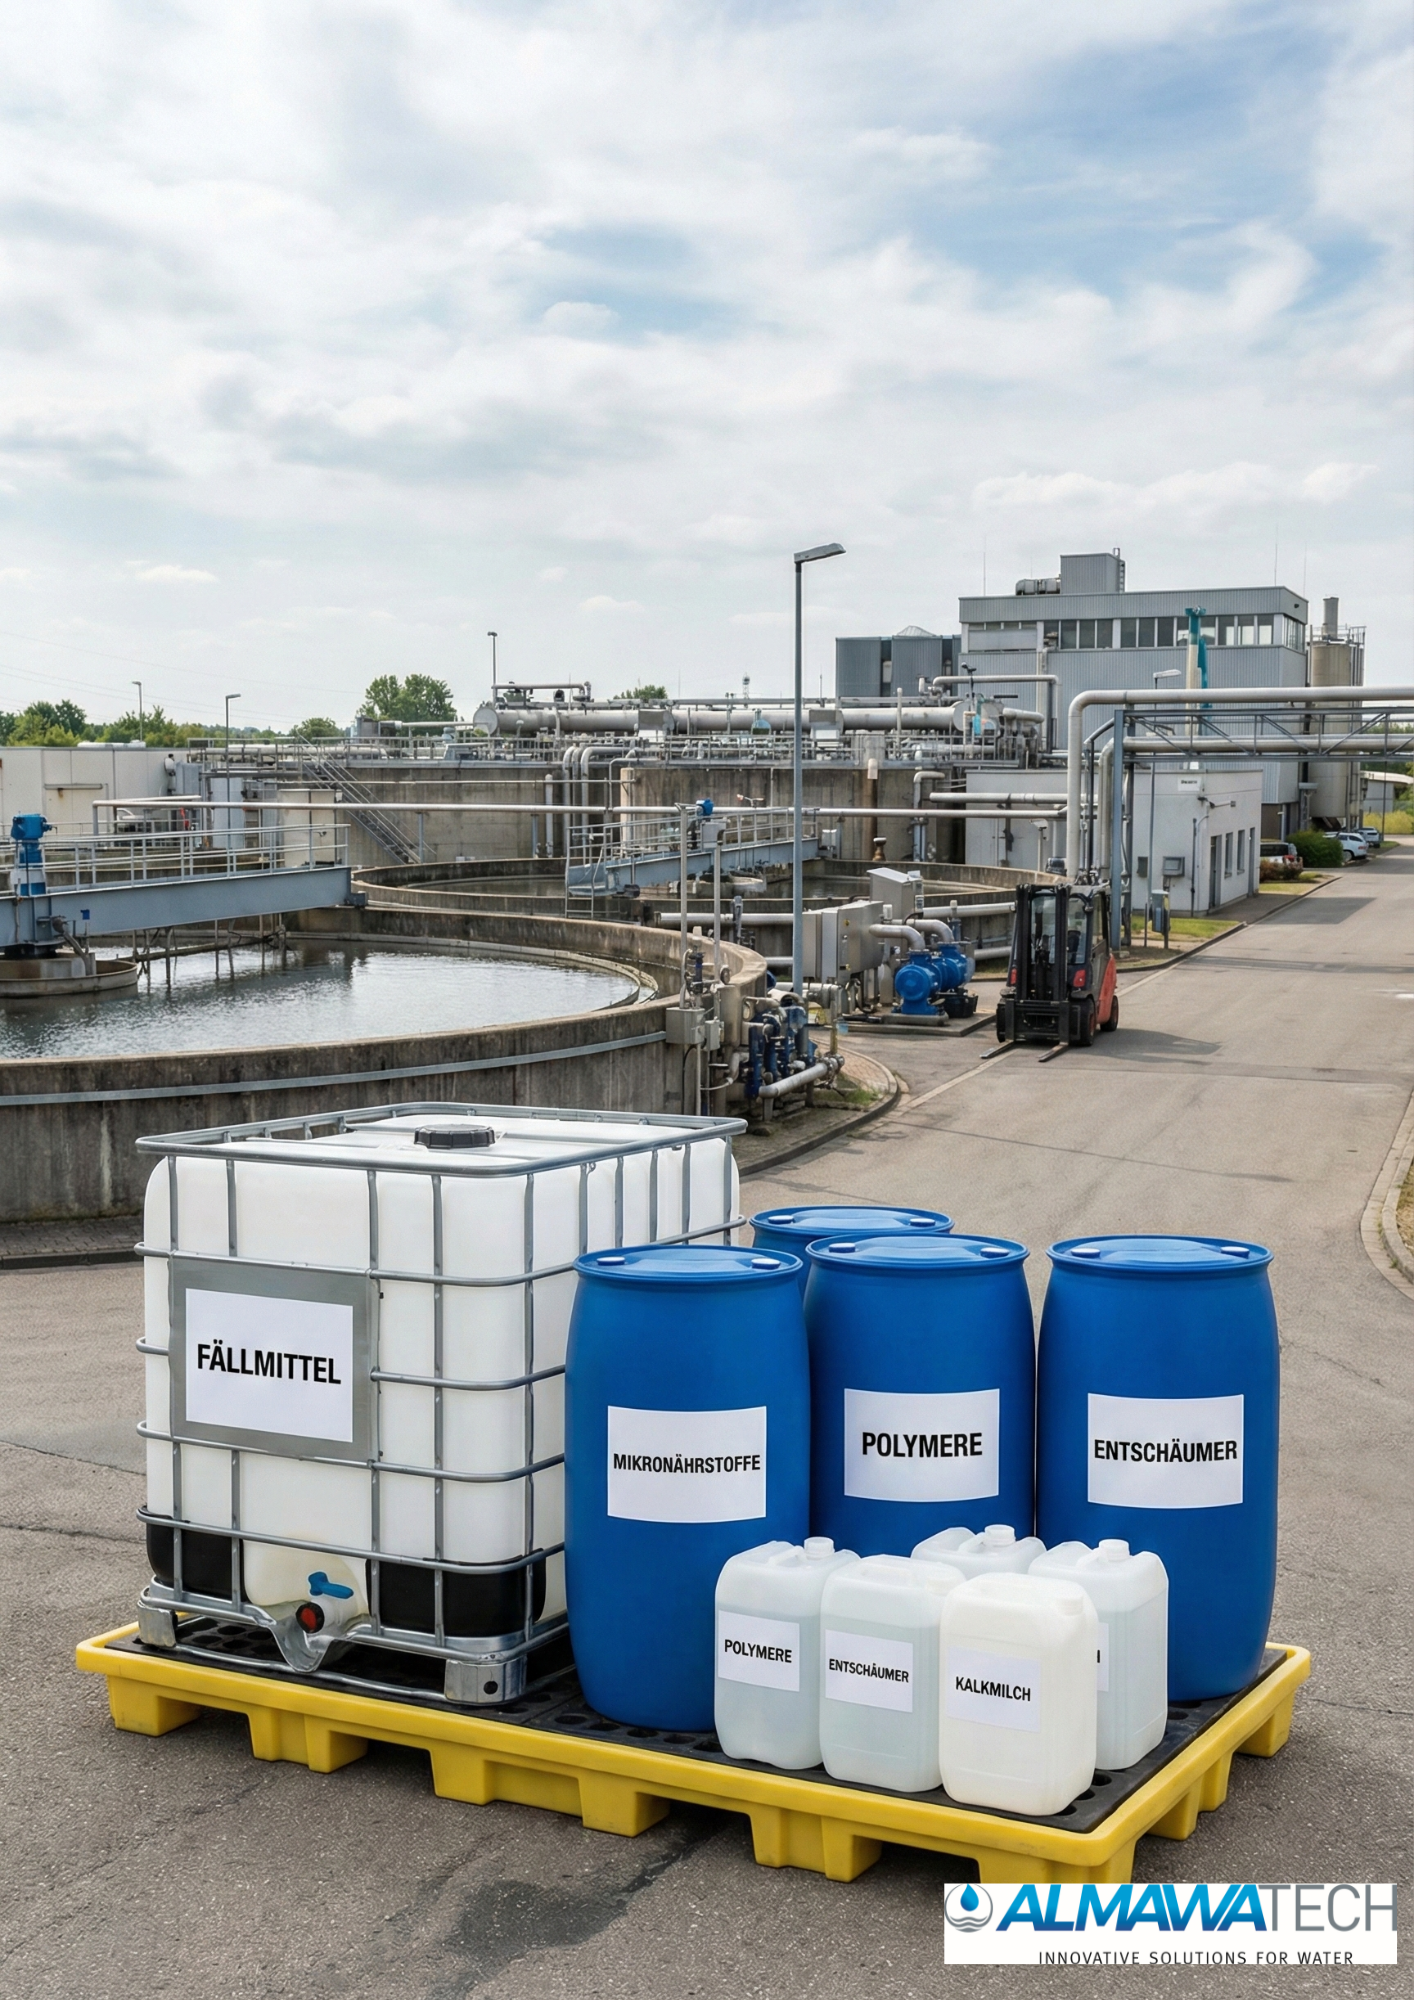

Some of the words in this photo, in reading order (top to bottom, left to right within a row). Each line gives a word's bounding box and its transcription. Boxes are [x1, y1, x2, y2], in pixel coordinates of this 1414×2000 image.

[197, 1338, 342, 1385] FÄLLMITTEL
[862, 1431, 983, 1458] POLYMERE
[1094, 1438, 1238, 1463] ENTSCHÄUMER
[613, 1453, 761, 1474] MIKRONÄHRSTOFFE
[724, 1639, 793, 1664] POLYMERE
[955, 1676, 1031, 1702] KALKMILCH
